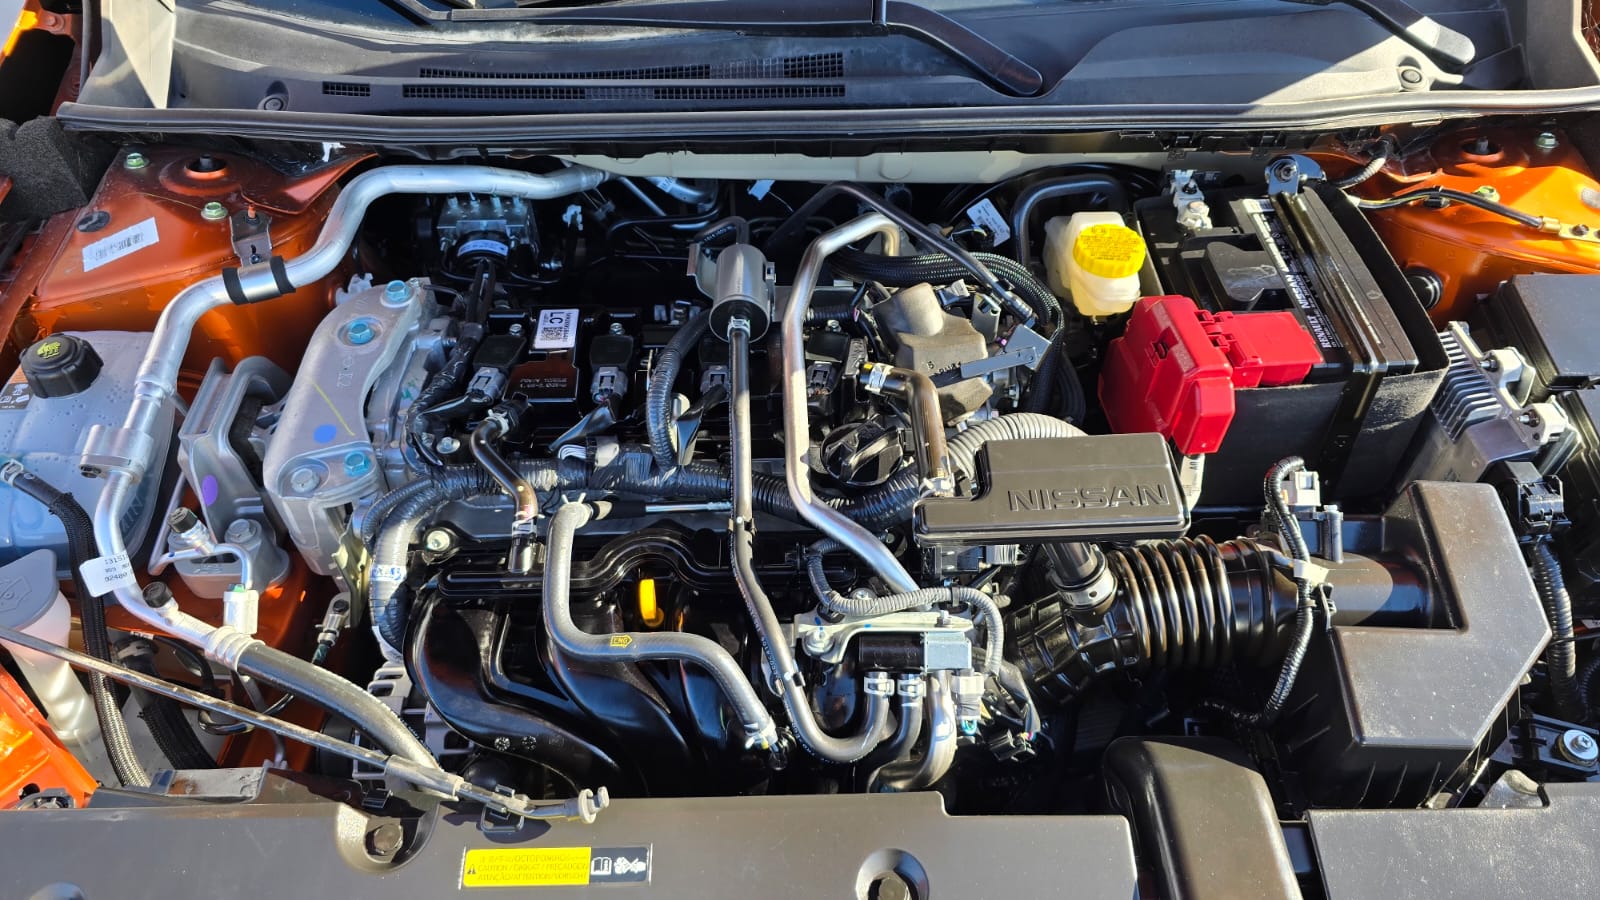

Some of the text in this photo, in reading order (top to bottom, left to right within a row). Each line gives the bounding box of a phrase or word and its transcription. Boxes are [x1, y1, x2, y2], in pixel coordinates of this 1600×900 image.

[1285, 274, 1311, 309] NISSAN
[549, 311, 565, 324] LC
[1307, 315, 1332, 348] RENAULT
[1008, 484, 1170, 512] NISSAN
